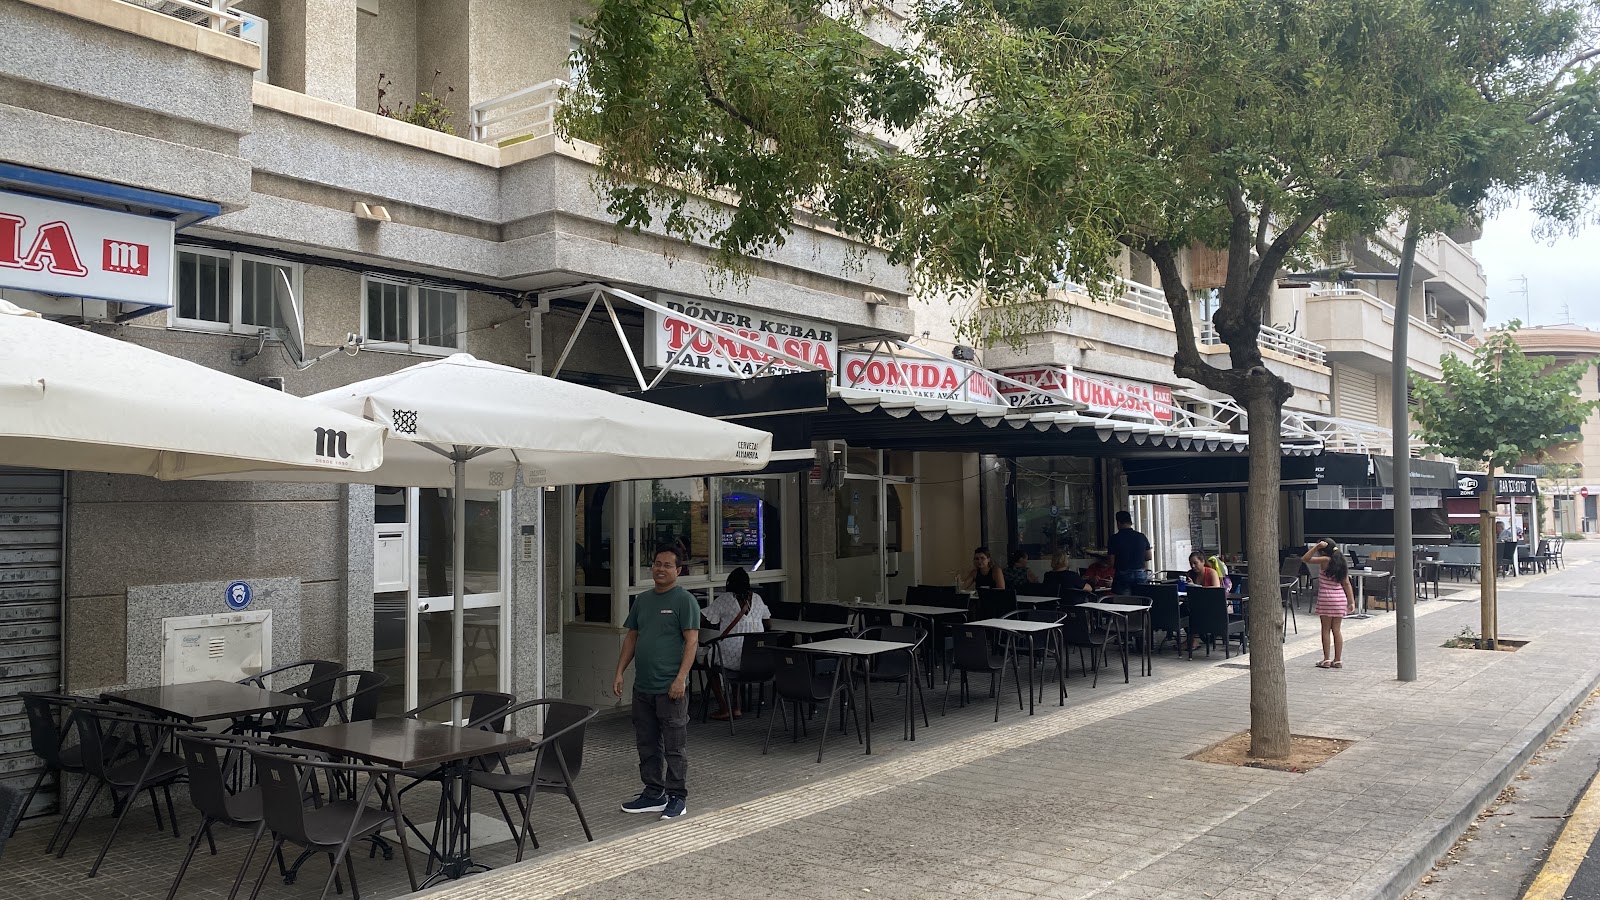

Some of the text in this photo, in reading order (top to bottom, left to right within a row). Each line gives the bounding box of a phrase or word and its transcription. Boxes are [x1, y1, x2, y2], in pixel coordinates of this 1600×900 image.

[666, 300, 833, 342] DÖNER KEBAB
[665, 351, 710, 370] BAR
[846, 358, 960, 389] COMIDA
